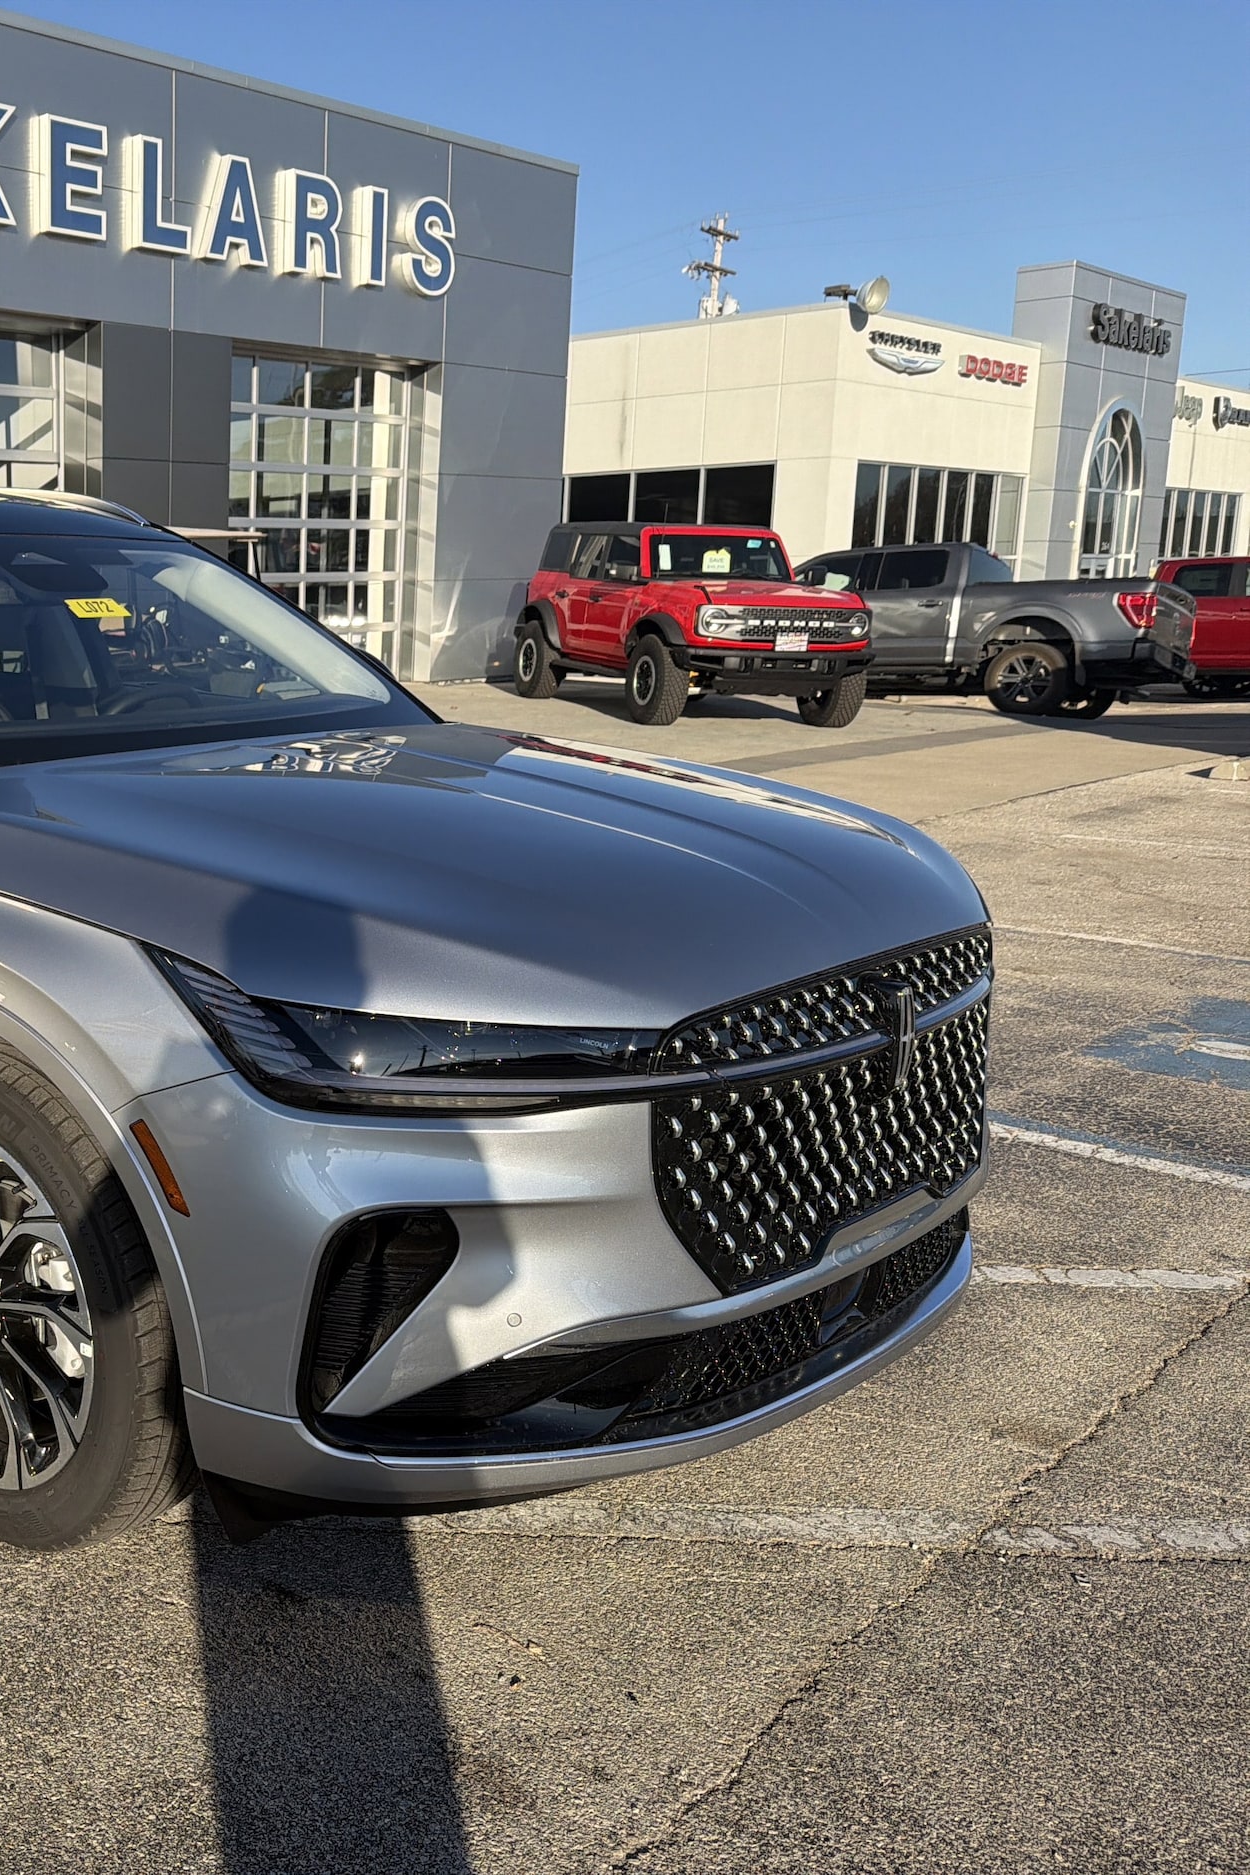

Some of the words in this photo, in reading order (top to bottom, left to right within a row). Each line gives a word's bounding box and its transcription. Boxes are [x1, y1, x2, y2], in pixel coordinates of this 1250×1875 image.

[1092, 302, 1172, 356] Sakelaris
[961, 354, 1028, 385] DODGE
[579, 1037, 609, 1049] LINCOLN
[29, 1144, 78, 1210] PRIMACY
